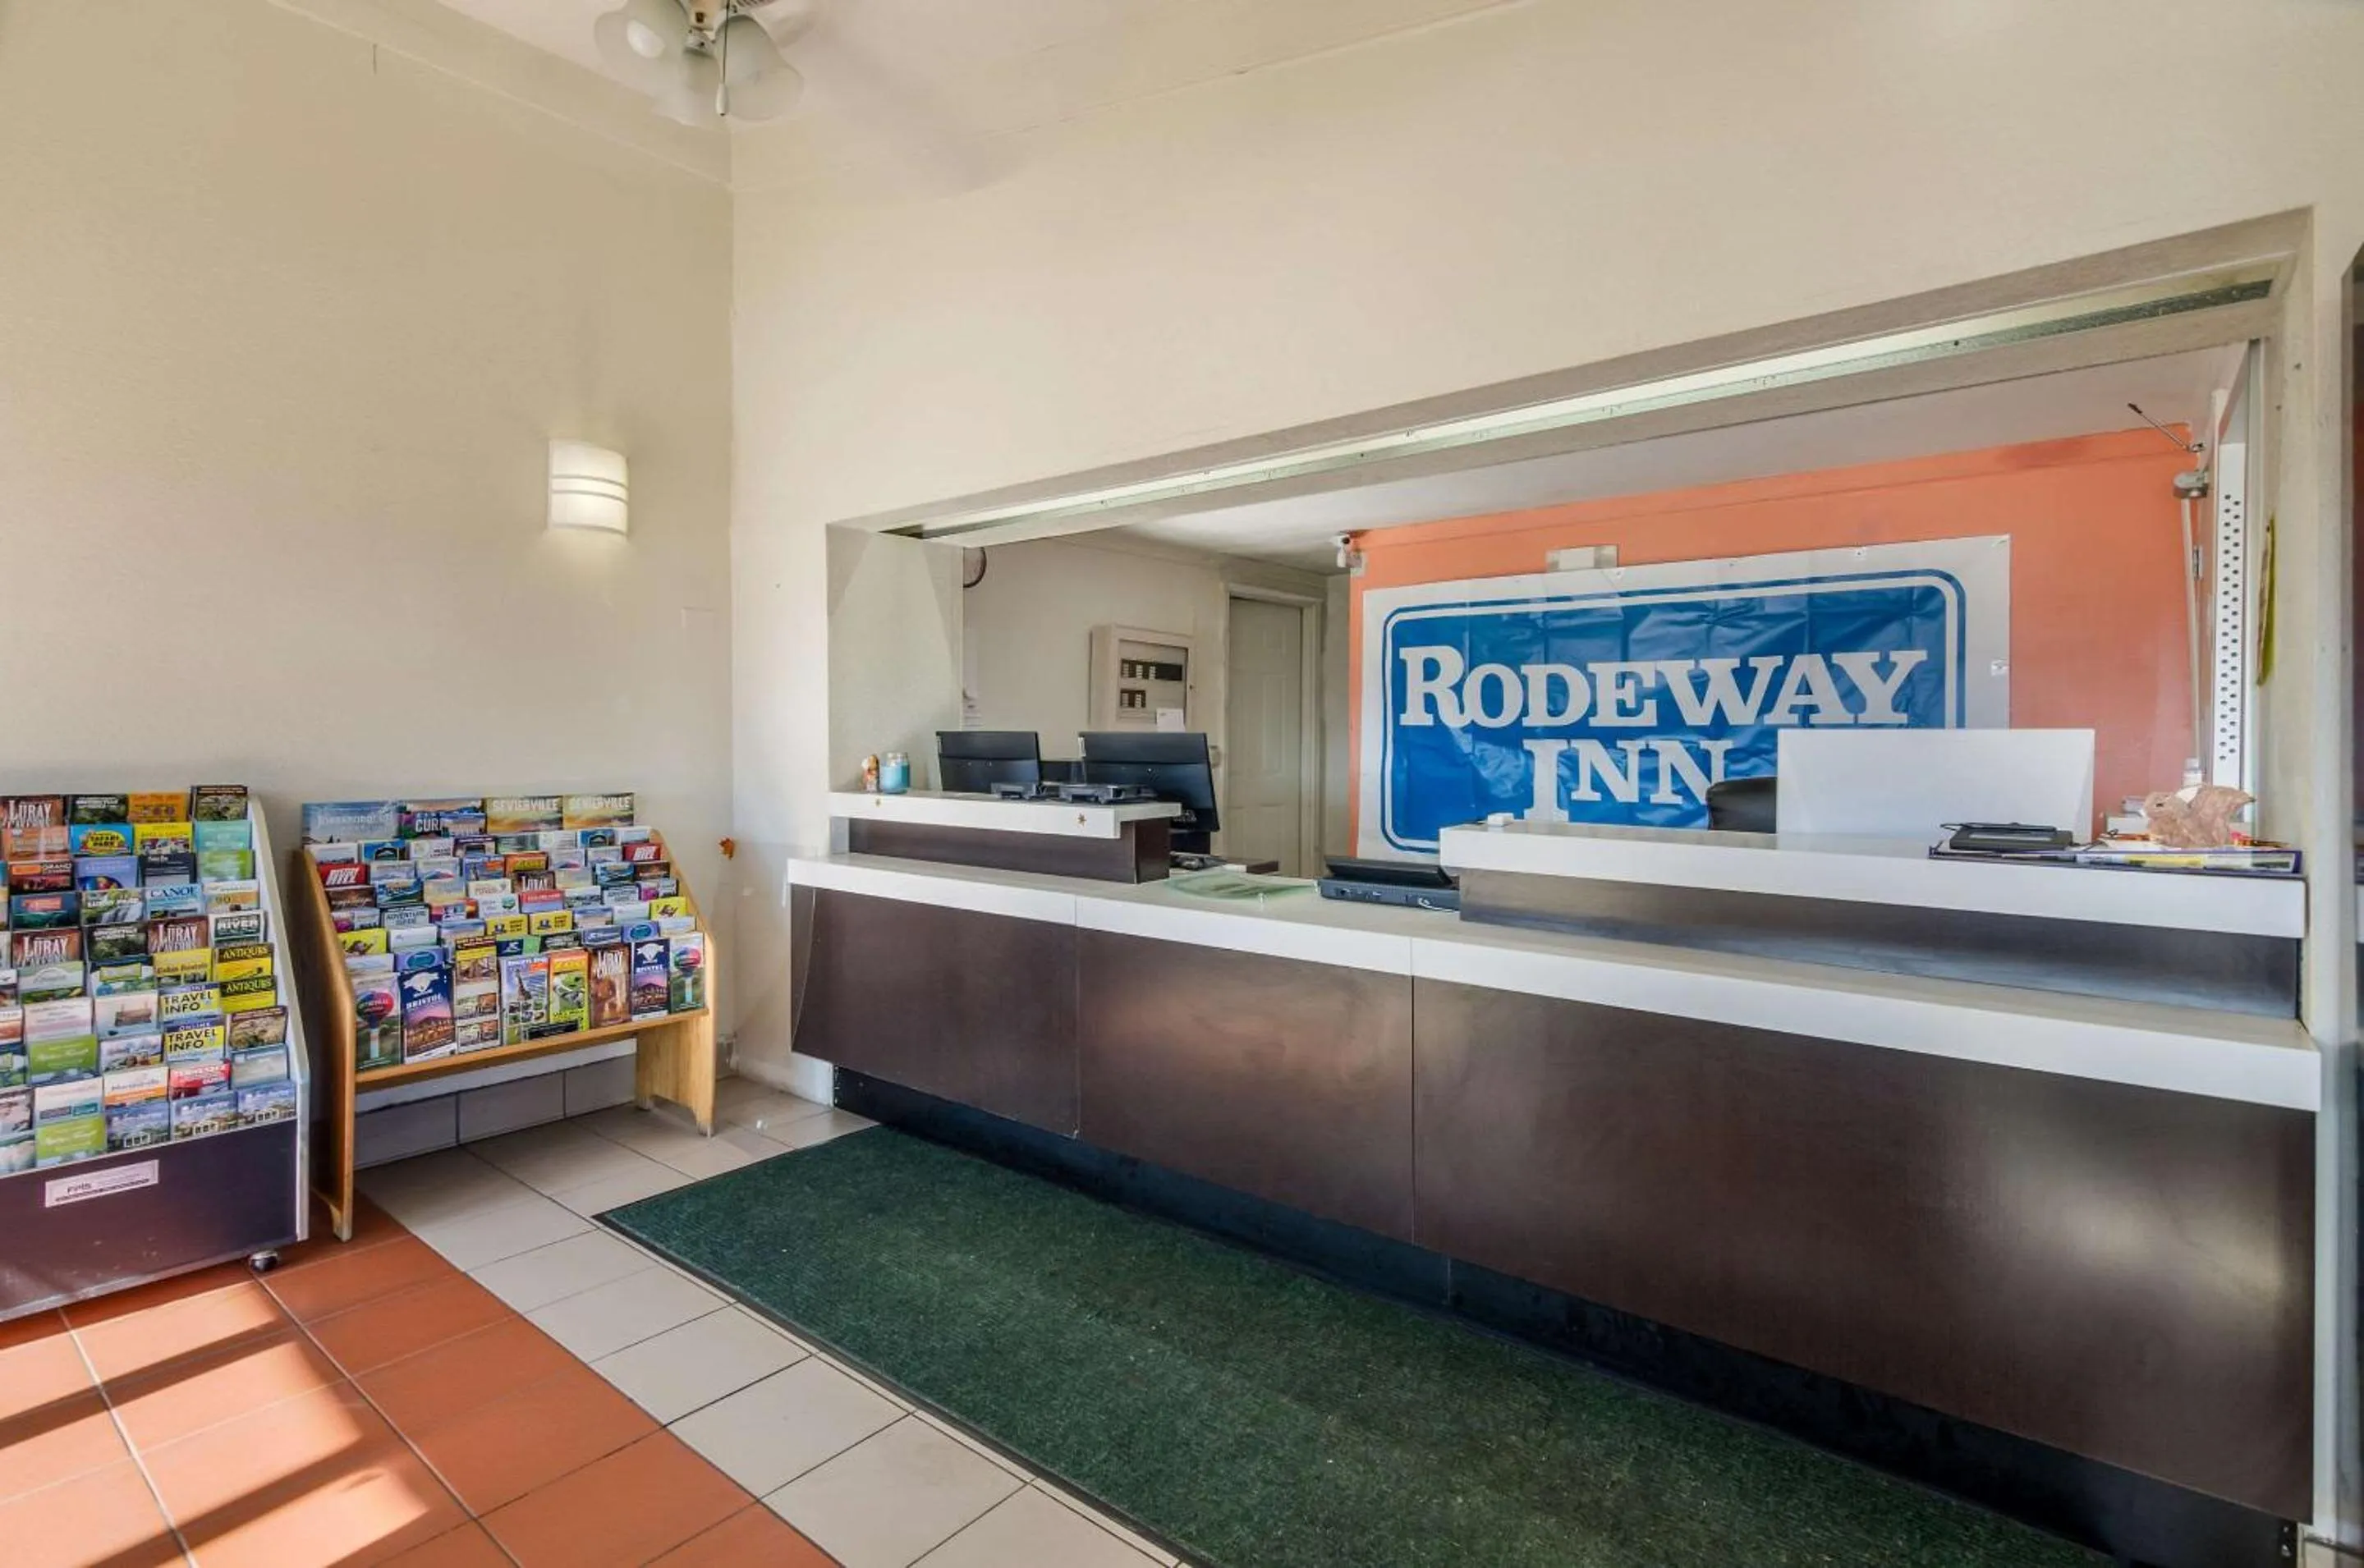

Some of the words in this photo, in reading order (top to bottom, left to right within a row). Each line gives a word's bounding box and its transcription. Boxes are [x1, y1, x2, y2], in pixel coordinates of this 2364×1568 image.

[1398, 645, 1927, 728] RODEWAY
[1523, 738, 1734, 822] INN
[9, 800, 52, 821] LURAY
[158, 924, 198, 945] LURAY
[23, 936, 69, 957] LURAY
[223, 946, 269, 960] ANTIQUES
[226, 977, 272, 993] ANTIQUES
[164, 990, 213, 1005] TRAVEL
[165, 1002, 201, 1016] INFO
[168, 1028, 217, 1043] TRAVEL
[169, 1039, 204, 1054] INFO
